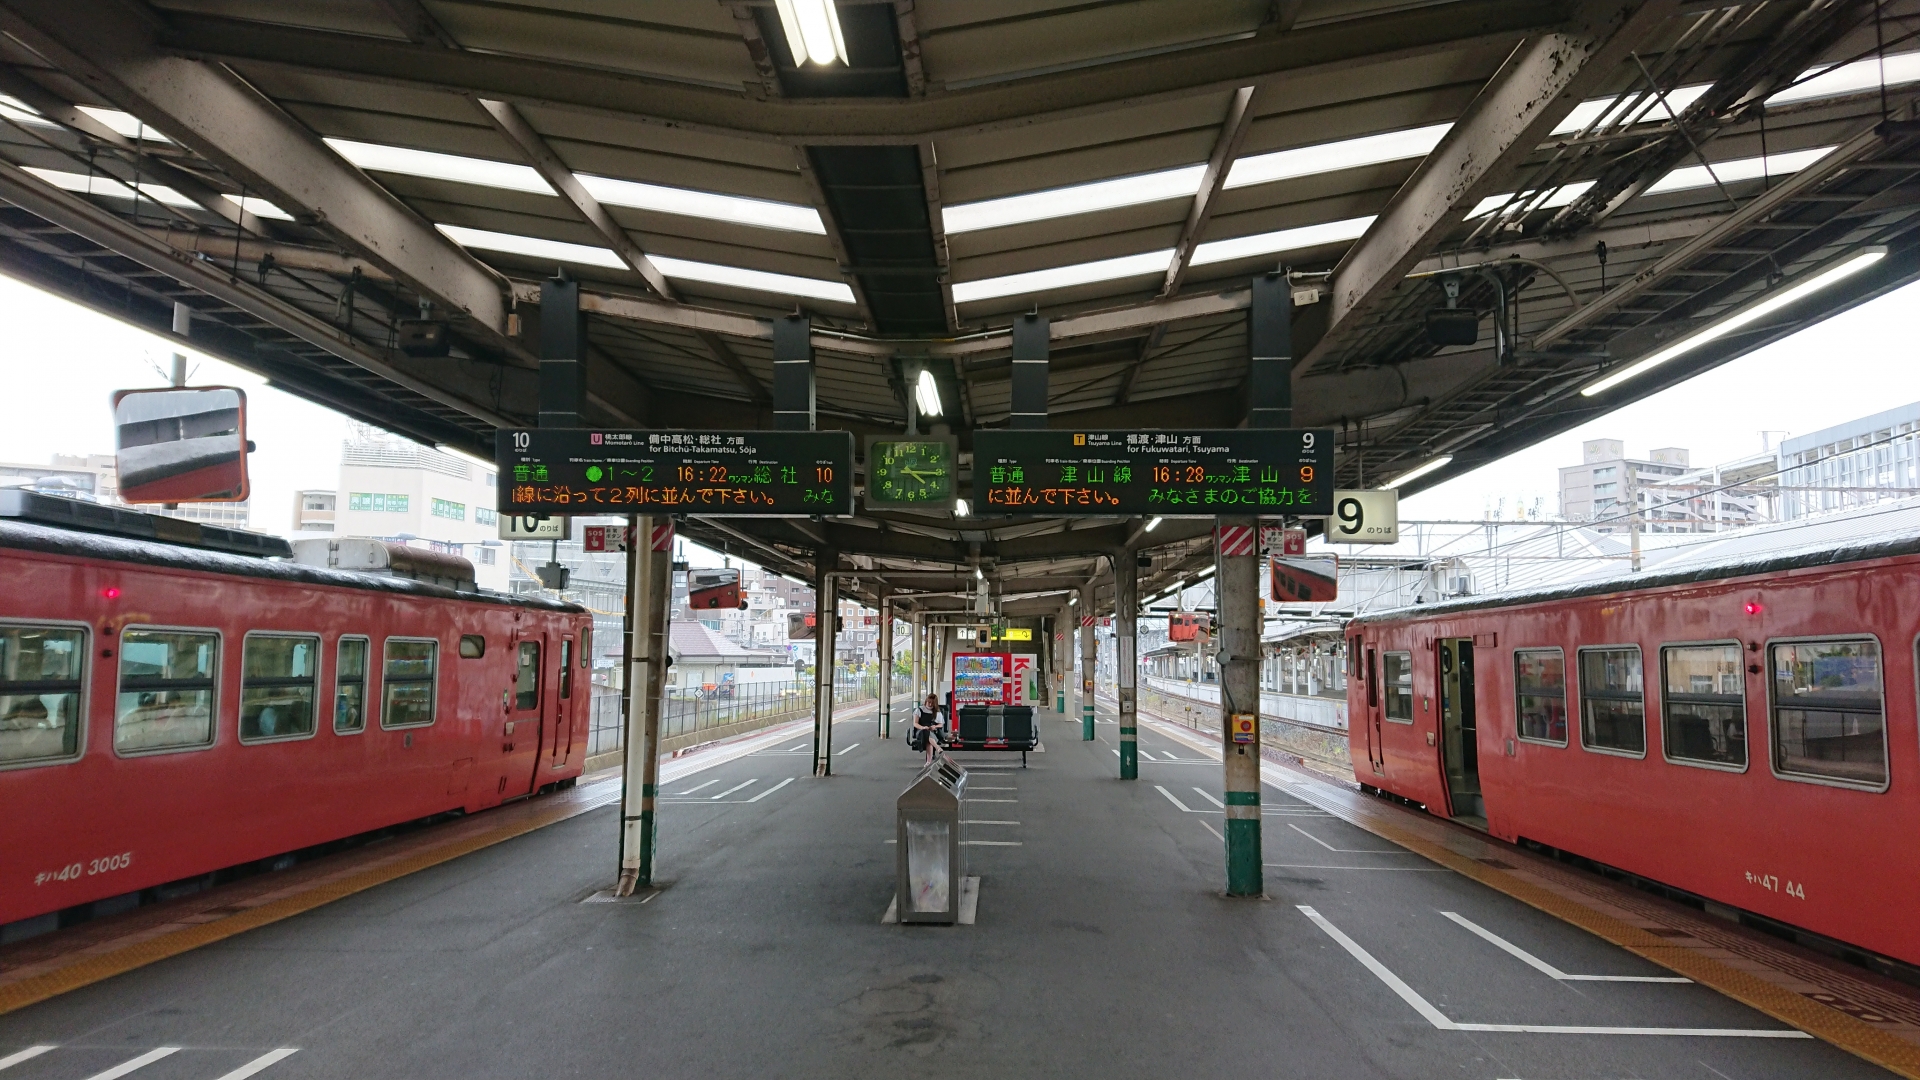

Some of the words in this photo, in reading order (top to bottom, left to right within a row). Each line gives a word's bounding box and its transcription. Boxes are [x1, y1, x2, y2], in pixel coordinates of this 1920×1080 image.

[513, 432, 530, 447] 10
[593, 434, 600, 443] U
[726, 436, 744, 445] 方面
[1076, 435, 1083, 444] T
[1182, 436, 1201, 444] 方面
[1302, 432, 1315, 449] 9
[649, 445, 661, 453] for
[894, 449, 904, 457] 11
[905, 445, 917, 453] 12
[921, 448, 926, 456] 1
[1127, 445, 1139, 453] for
[1141, 445, 1191, 454] Fukuwatari,
[1193, 445, 1230, 455] Tsuyama
[884, 457, 895, 465] 10
[929, 455, 937, 463] 2
[513, 464, 548, 482] 普通
[677, 466, 727, 483] 16:22
[728, 475, 752, 484] ワンマン
[753, 466, 798, 484] 総社
[816, 467, 833, 483] 10
[879, 468, 887, 476] 9
[935, 468, 943, 476] 3
[990, 465, 1024, 483] 普通
[1153, 466, 1204, 483] 16:28
[1205, 475, 1231, 484] ワンマン
[1300, 466, 1314, 483] 9
[512, 485, 774, 504] 線に沿って2列に並んで下さい。
[803, 488, 834, 504] みな
[895, 488, 903, 496] 7
[919, 488, 926, 496] 5
[988, 486, 1120, 505] に並んで下さい。
[1149, 486, 1318, 505] みなさまのご協力を
[1337, 497, 1364, 535] 9
[1366, 526, 1392, 534] のりば
[896, 626, 905, 635] 10
[34, 863, 82, 887] キハ40
[87, 852, 131, 876] 3005
[1745, 870, 1778, 893] キハ47
[1785, 881, 1806, 900] 44
